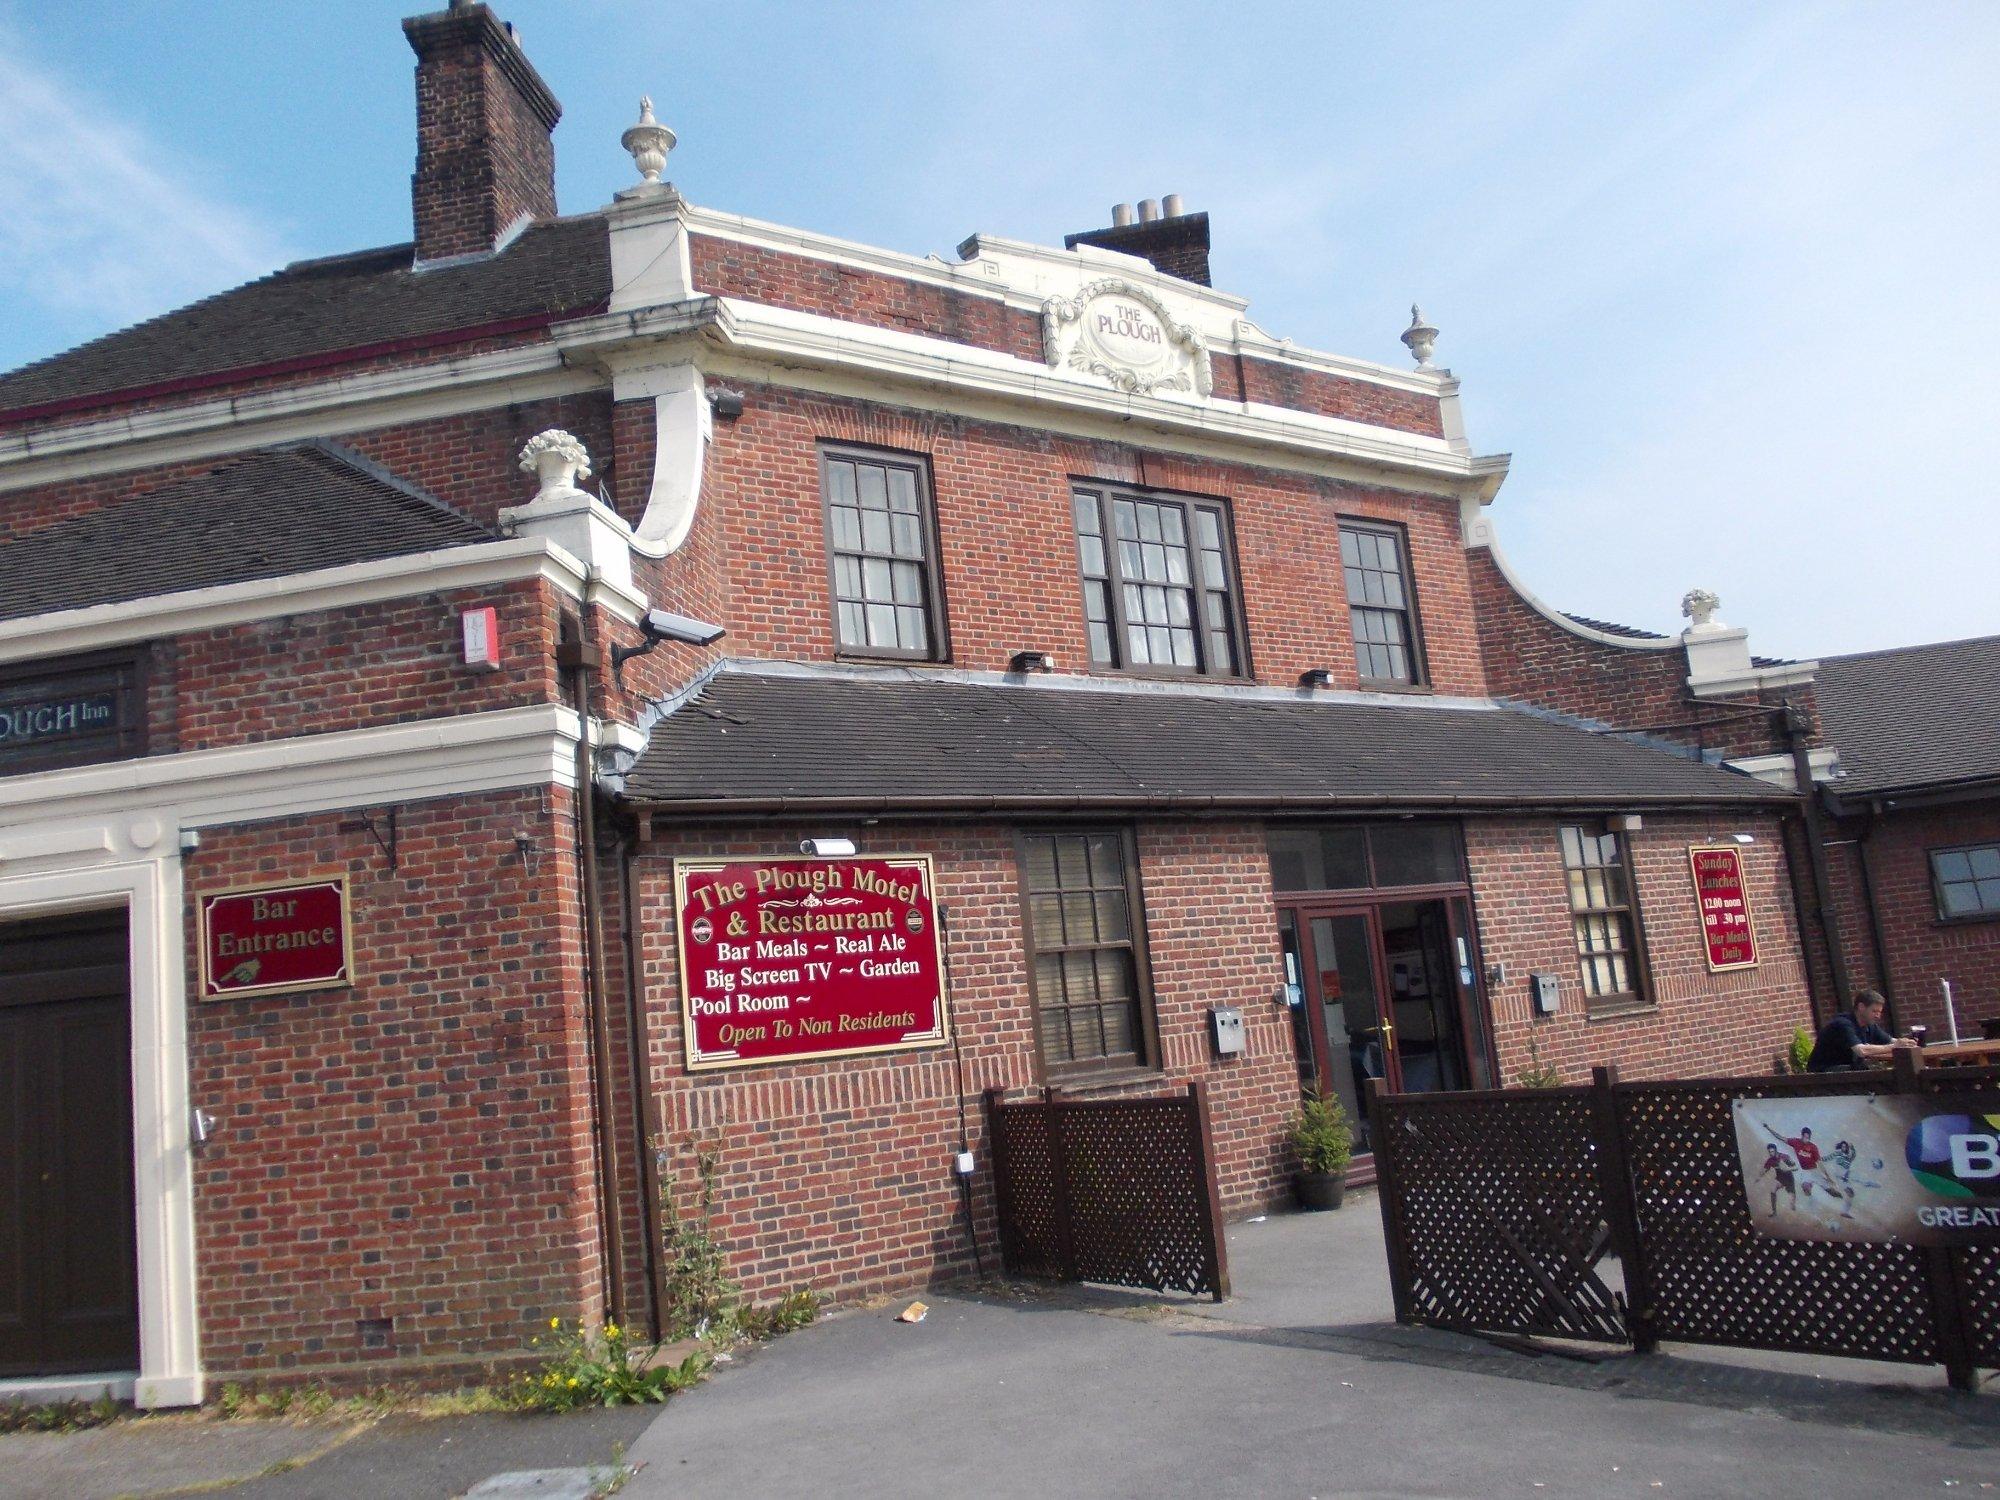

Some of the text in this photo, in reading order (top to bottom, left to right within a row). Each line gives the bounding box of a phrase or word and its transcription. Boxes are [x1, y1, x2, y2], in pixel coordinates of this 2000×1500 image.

[1114, 304, 1142, 321] THE
[1097, 314, 1162, 344] PLOUGH
[82, 702, 110, 721] Inn
[1697, 854, 1733, 872] Sunday
[692, 865, 918, 912] The Plough Motel
[1699, 873, 1739, 889] Lunches
[251, 897, 299, 922] Bar
[1723, 898, 1742, 908] noon
[726, 907, 895, 936] & Restaurant
[1705, 913, 1718, 925] till
[1734, 914, 1746, 926] pm
[217, 926, 336, 957] Entrance
[717, 942, 751, 961] Bar
[755, 938, 808, 959] Meals
[834, 934, 873, 954] Real
[878, 933, 907, 951] Ale
[1710, 930, 1748, 945] Bar Meals
[1722, 946, 1742, 960] Daily
[704, 969, 736, 991] Big
[740, 966, 800, 987] Screen
[803, 961, 833, 981] TV
[859, 957, 920, 977] Garden
[689, 995, 731, 1016] Pool
[737, 994, 790, 1013] Room
[719, 1010, 916, 1047] Open To Non Residents
[1917, 1205, 2000, 1228] GREAT
